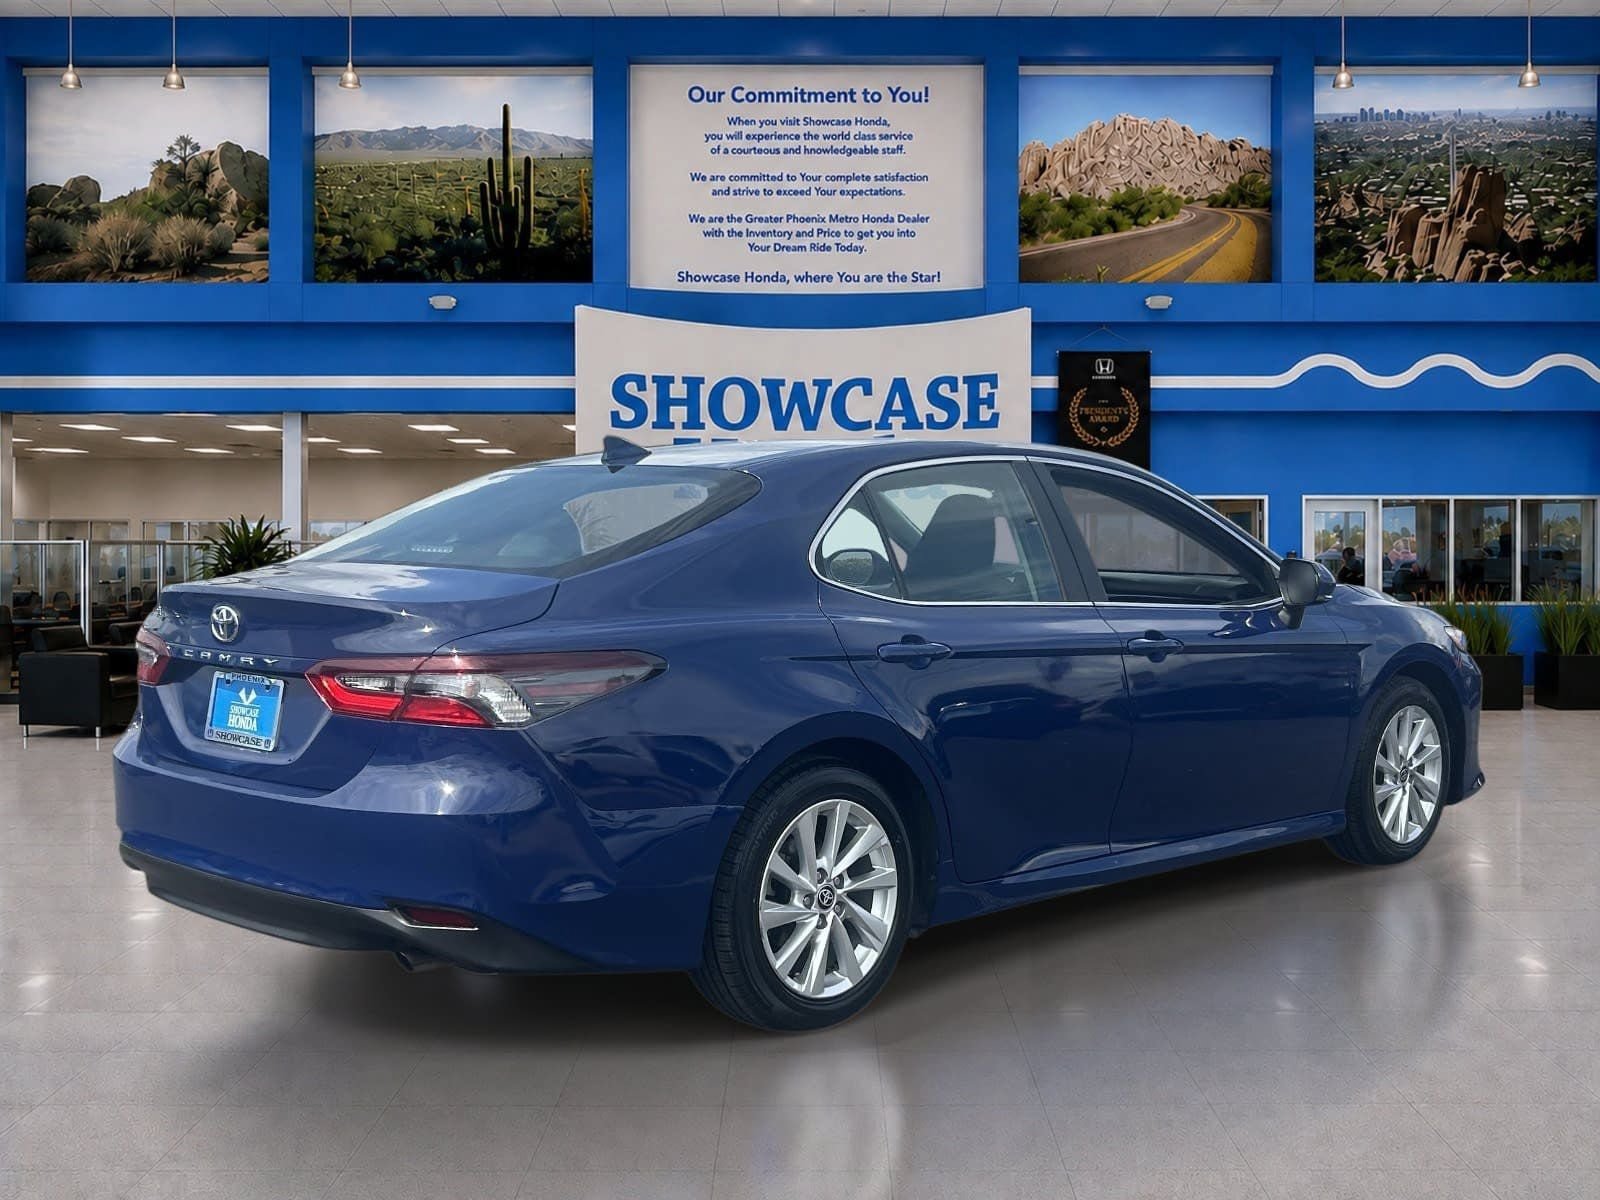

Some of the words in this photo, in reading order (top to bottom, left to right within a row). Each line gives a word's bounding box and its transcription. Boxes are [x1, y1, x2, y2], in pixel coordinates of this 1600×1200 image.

[687, 85, 726, 104] Our
[730, 85, 857, 104] Commitment
[861, 87, 883, 104] to
[886, 85, 930, 104] You!
[726, 116, 757, 127] When
[758, 118, 778, 129] you
[779, 116, 801, 127] visit
[802, 116, 853, 127] Showcase
[854, 116, 891, 129] Honda,
[704, 132, 724, 143] you
[725, 130, 743, 141] will
[745, 130, 801, 143] experience
[802, 130, 820, 141] the
[821, 130, 851, 141] world
[853, 130, 877, 141] class
[878, 130, 914, 141] service
[710, 144, 721, 155] of
[722, 146, 729, 155] a
[730, 145, 781, 155] courteous
[782, 144, 802, 155] and
[881, 144, 907, 155] staff.
[689, 171, 708, 183] We
[709, 174, 726, 183] are
[728, 171, 784, 183] committed
[786, 173, 798, 183] to
[799, 171, 823, 183] Your
[824, 171, 872, 185] complete
[873, 171, 929, 183] satisfaction
[711, 186, 731, 197] and
[732, 186, 761, 197] strive
[762, 187, 774, 197] to
[775, 186, 812, 197] exceed
[814, 186, 838, 197] Your
[839, 186, 907, 200] expectations.
[688, 213, 706, 224] We
[707, 216, 725, 224] are
[726, 213, 743, 224] the
[744, 213, 784, 224] Greater
[785, 213, 827, 224] Phoenix
[828, 213, 860, 224] Metro
[861, 213, 895, 224] Honda
[897, 213, 931, 224] Dealer
[702, 227, 725, 238] with
[726, 227, 744, 238] the
[745, 227, 794, 241] Inventory
[795, 227, 815, 238] and
[816, 227, 842, 238] Price
[843, 229, 855, 238] to
[856, 229, 875, 241] get
[876, 230, 895, 241] you
[896, 227, 917, 238] into
[747, 242, 772, 253] Your
[773, 242, 807, 253] Dream
[809, 242, 833, 253] Ride
[834, 242, 868, 255] Today.
[677, 270, 741, 284] Showcase
[744, 270, 790, 286] Honda,
[793, 270, 834, 284] where
[836, 270, 861, 284] You
[863, 274, 884, 284] are
[886, 270, 908, 284] the
[911, 270, 941, 284] Star!
[609, 373, 1000, 431] SHOWCASE
[183, 649, 279, 665] CAMRY
[231, 673, 265, 684] PHOENIX
[229, 705, 260, 717] SHOWCASE
[227, 715, 258, 731] HONDA
[215, 730, 263, 746] SHOWCASE
